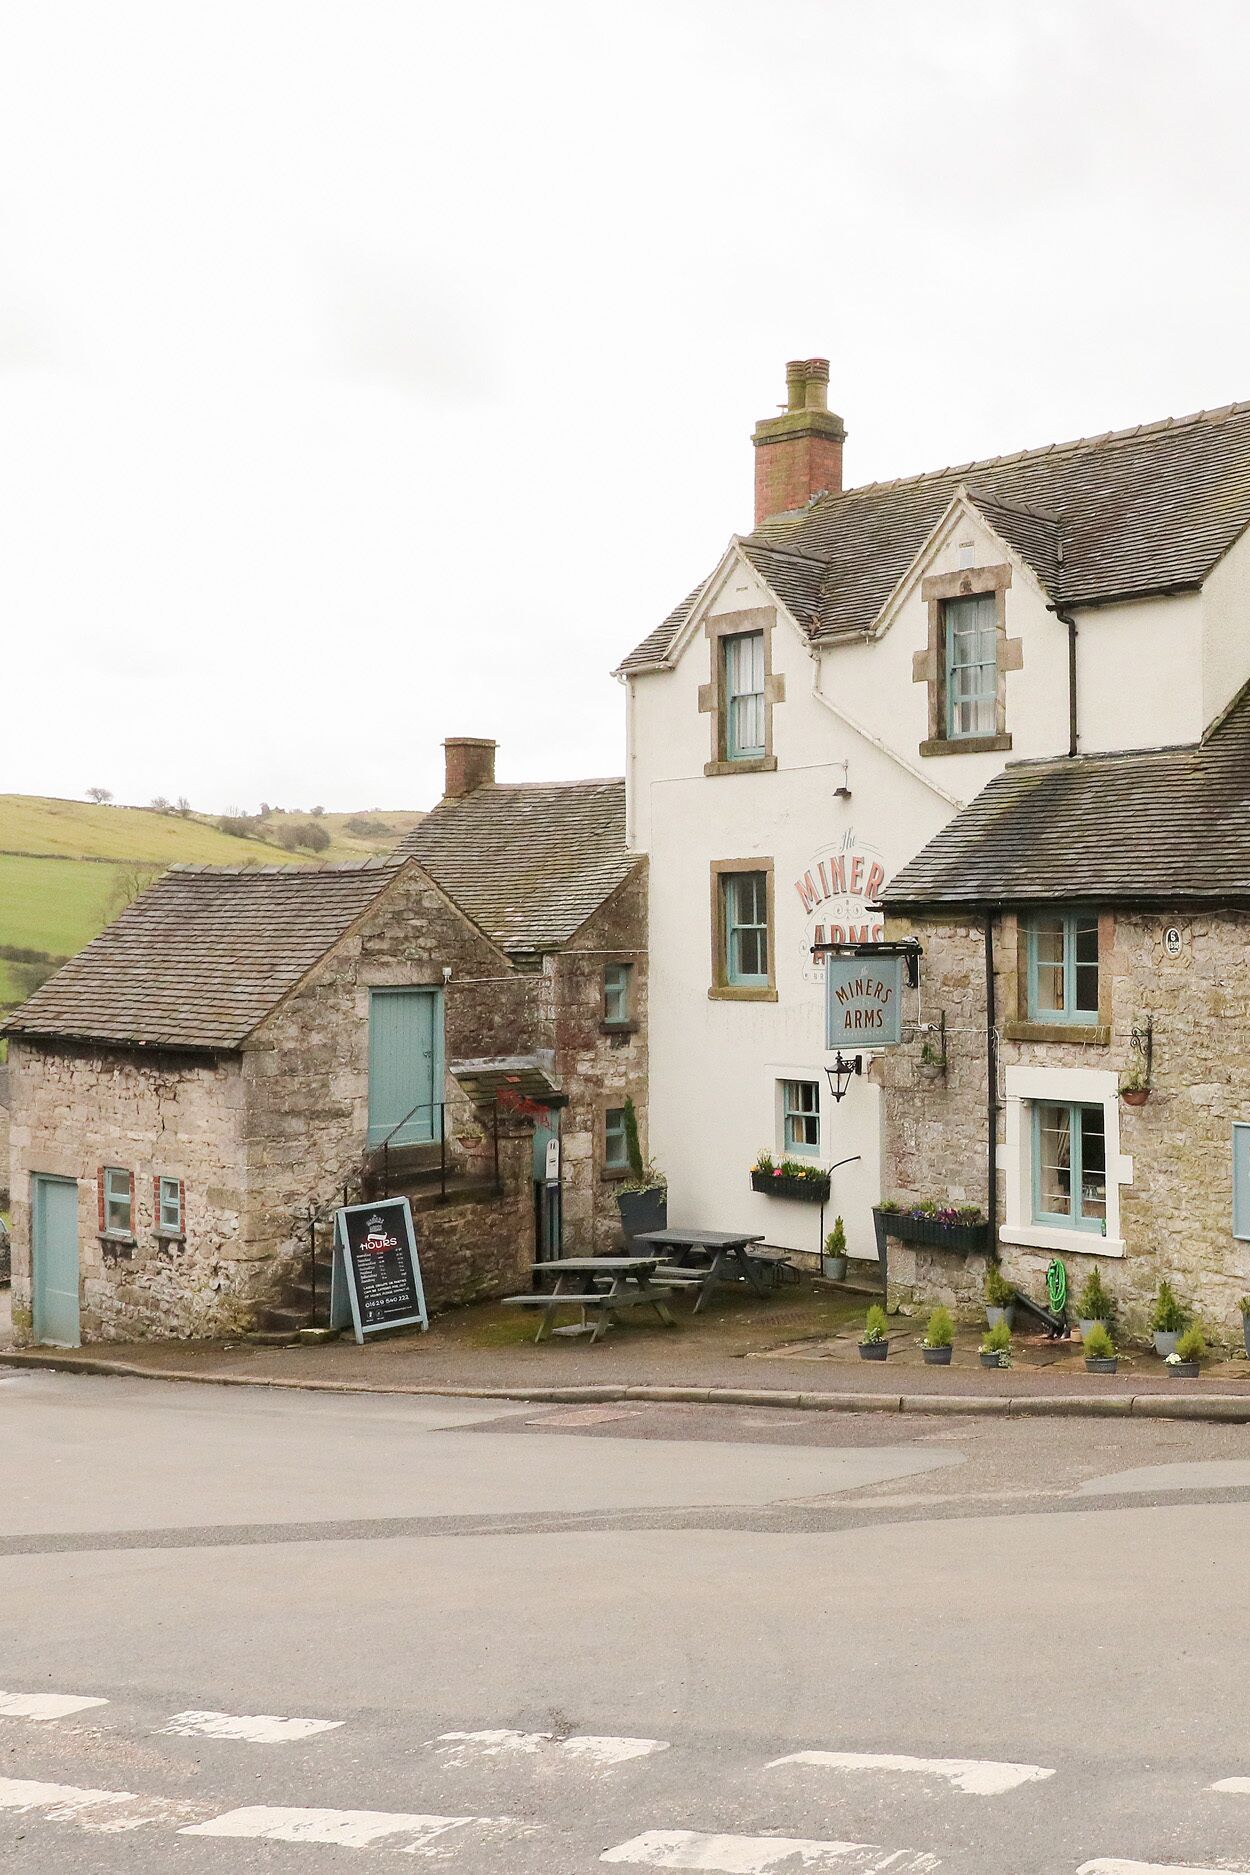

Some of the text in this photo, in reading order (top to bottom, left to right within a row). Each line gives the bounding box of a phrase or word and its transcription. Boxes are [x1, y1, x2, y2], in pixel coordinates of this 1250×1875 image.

[794, 854, 885, 915] MINER
[835, 979, 892, 1006] MINERS
[845, 1009, 883, 1028] ARMS
[360, 1237, 398, 1250] HOURS
[365, 1300, 384, 1308] 01629
